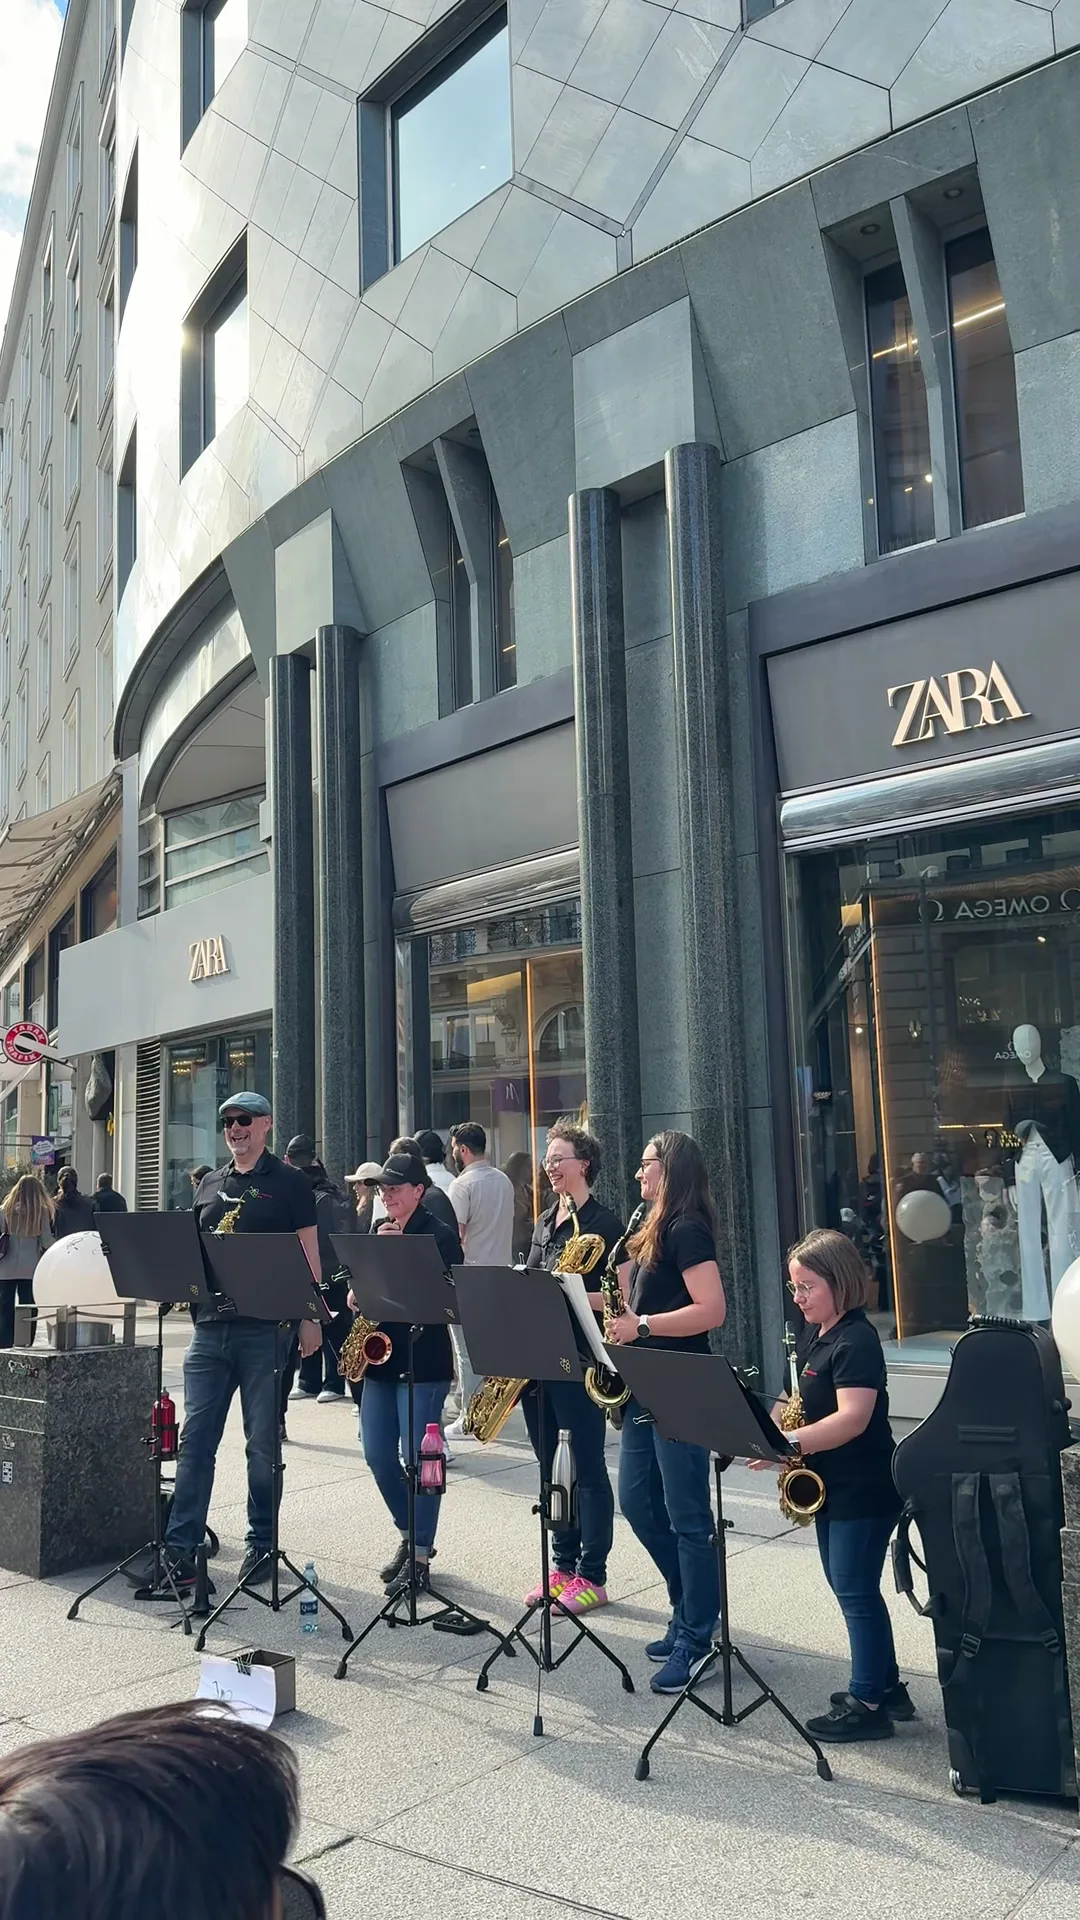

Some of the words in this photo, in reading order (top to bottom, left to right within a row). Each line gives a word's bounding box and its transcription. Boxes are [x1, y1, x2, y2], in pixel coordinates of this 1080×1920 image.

[887, 659, 1032, 746] ZARA
[188, 934, 229, 981] ZARA
[12, 1025, 46, 1040] TABAK
[6, 1039, 37, 1061] TRAFIK
